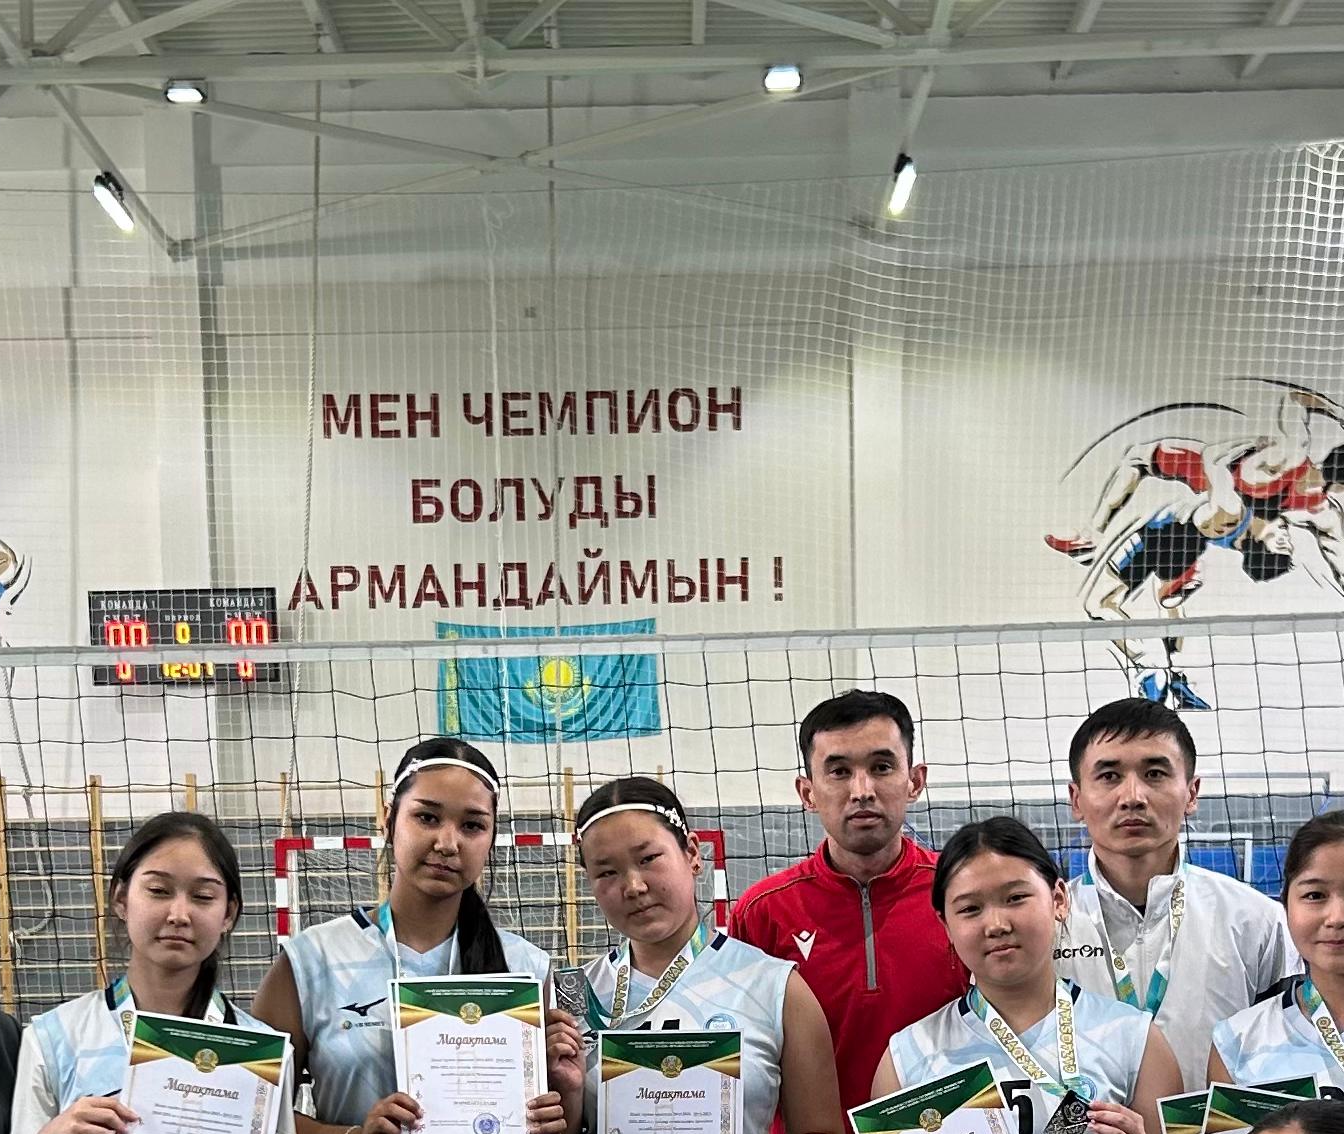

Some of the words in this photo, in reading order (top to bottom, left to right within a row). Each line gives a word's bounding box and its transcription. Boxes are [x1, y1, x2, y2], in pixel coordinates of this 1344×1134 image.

[322, 392, 440, 439] МЕН
[462, 386, 743, 437] ЧЕМПИОН
[411, 474, 657, 528] БОЛУДЫ
[288, 547, 750, 612] АРМАНДАЙМЫН
[436, 1033, 508, 1050] Мадақтама
[163, 1077, 240, 1100] Мадақтама
[635, 1087, 706, 1104] Мадақтама
